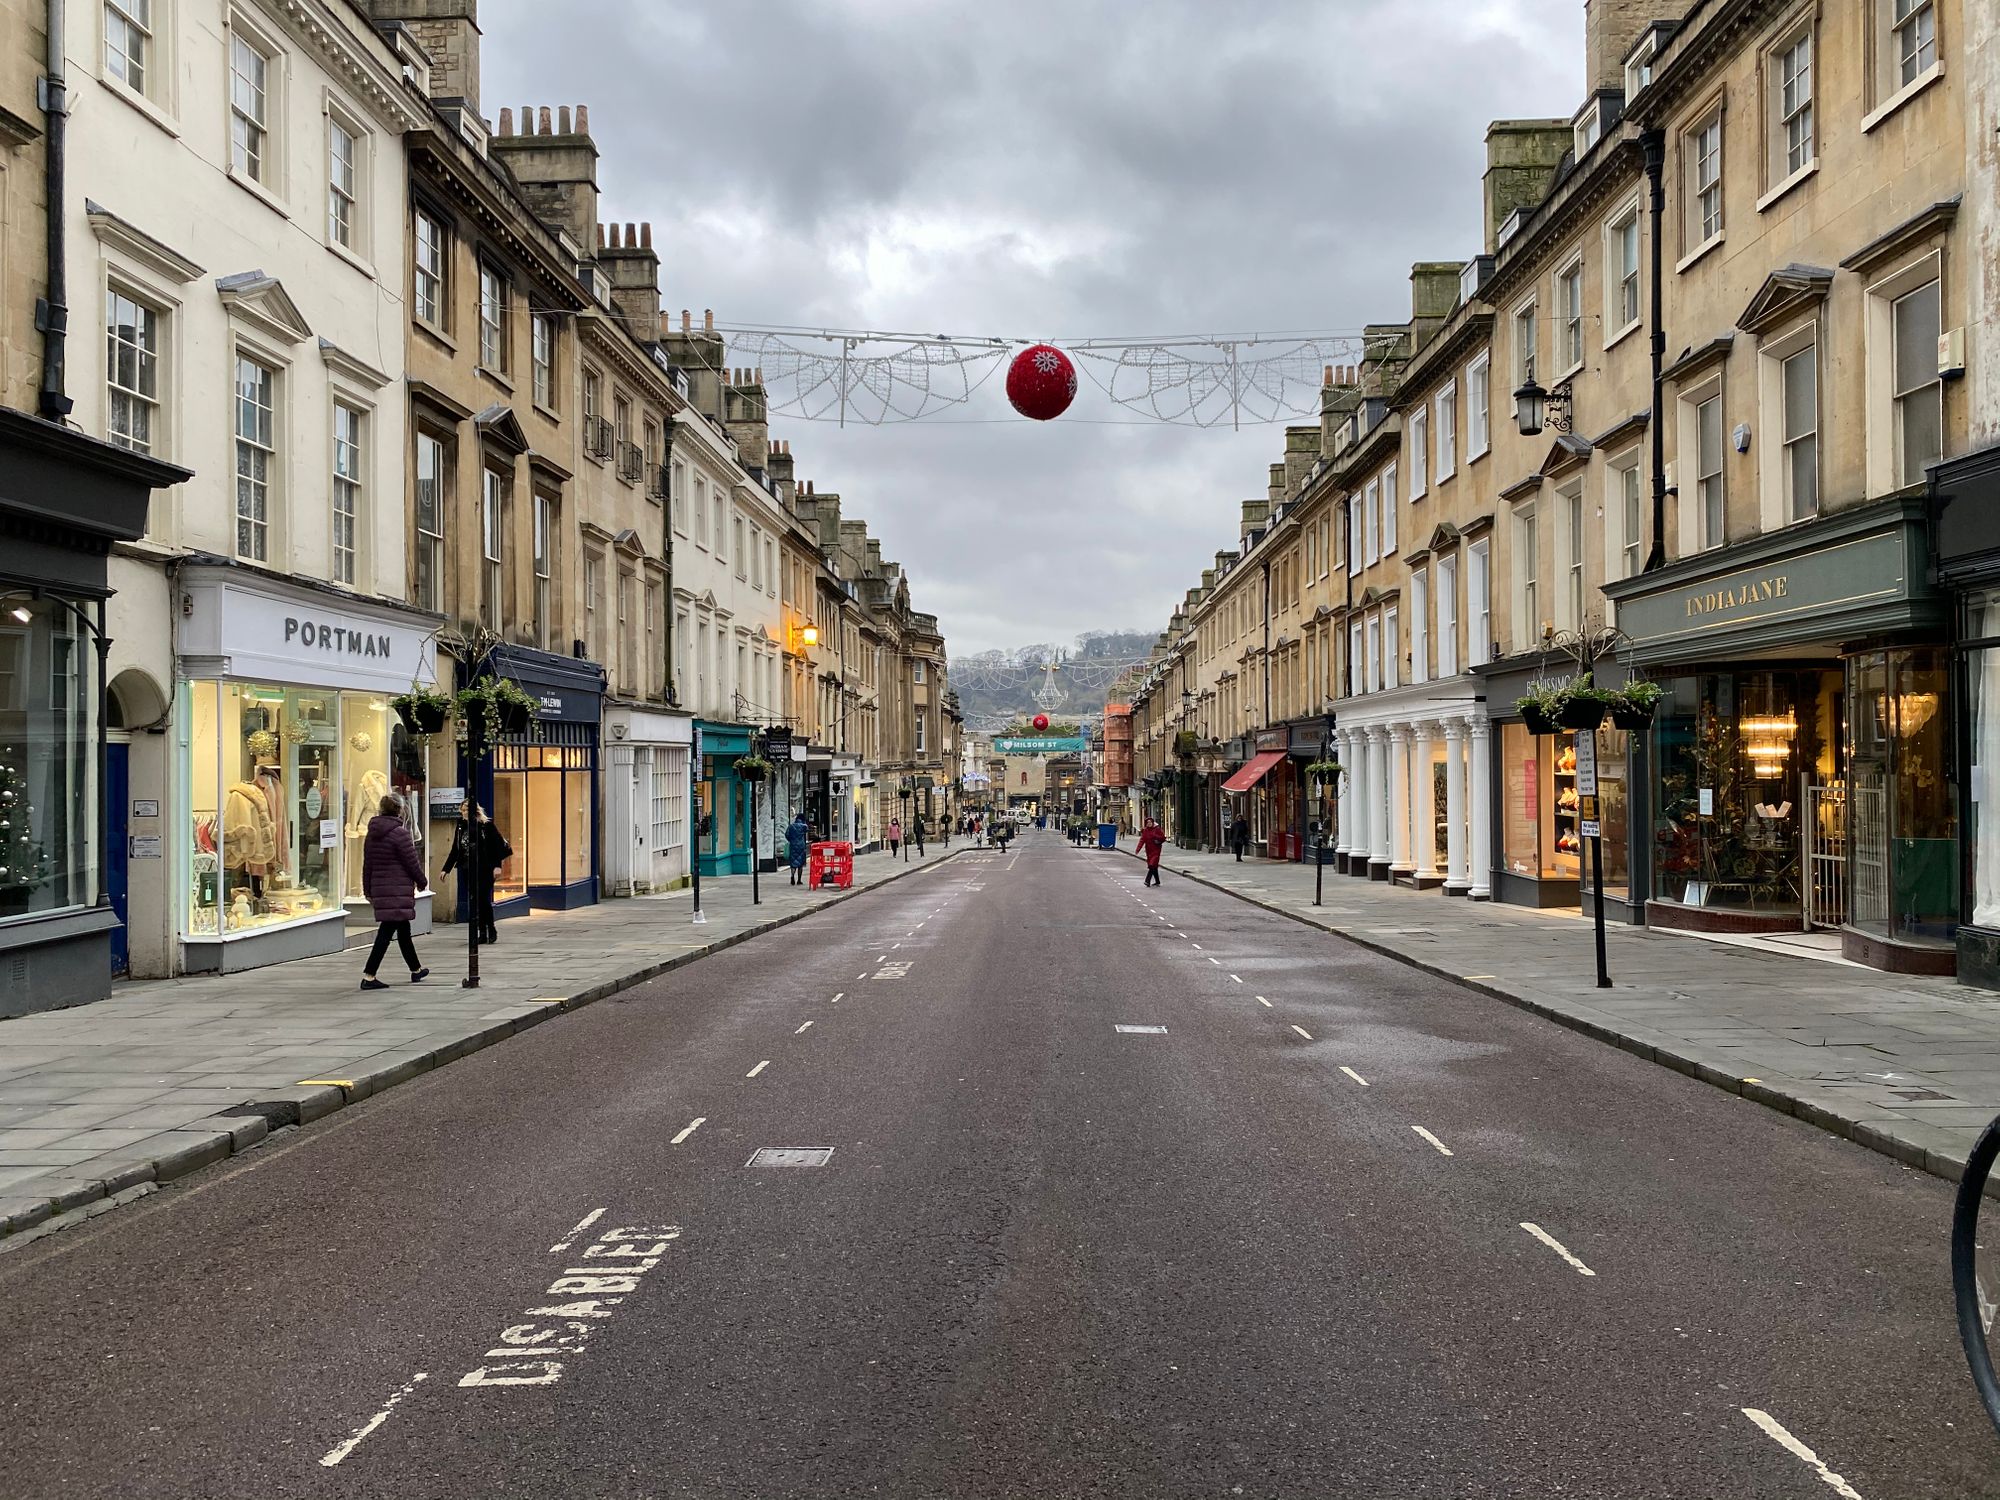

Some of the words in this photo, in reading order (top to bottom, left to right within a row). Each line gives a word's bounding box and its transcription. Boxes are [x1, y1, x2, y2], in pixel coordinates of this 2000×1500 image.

[1686, 590, 1736, 617] INDIA
[1739, 576, 1787, 606] JANE
[285, 617, 391, 658] PORTMAN
[458, 1224, 684, 1387] DISABLED
